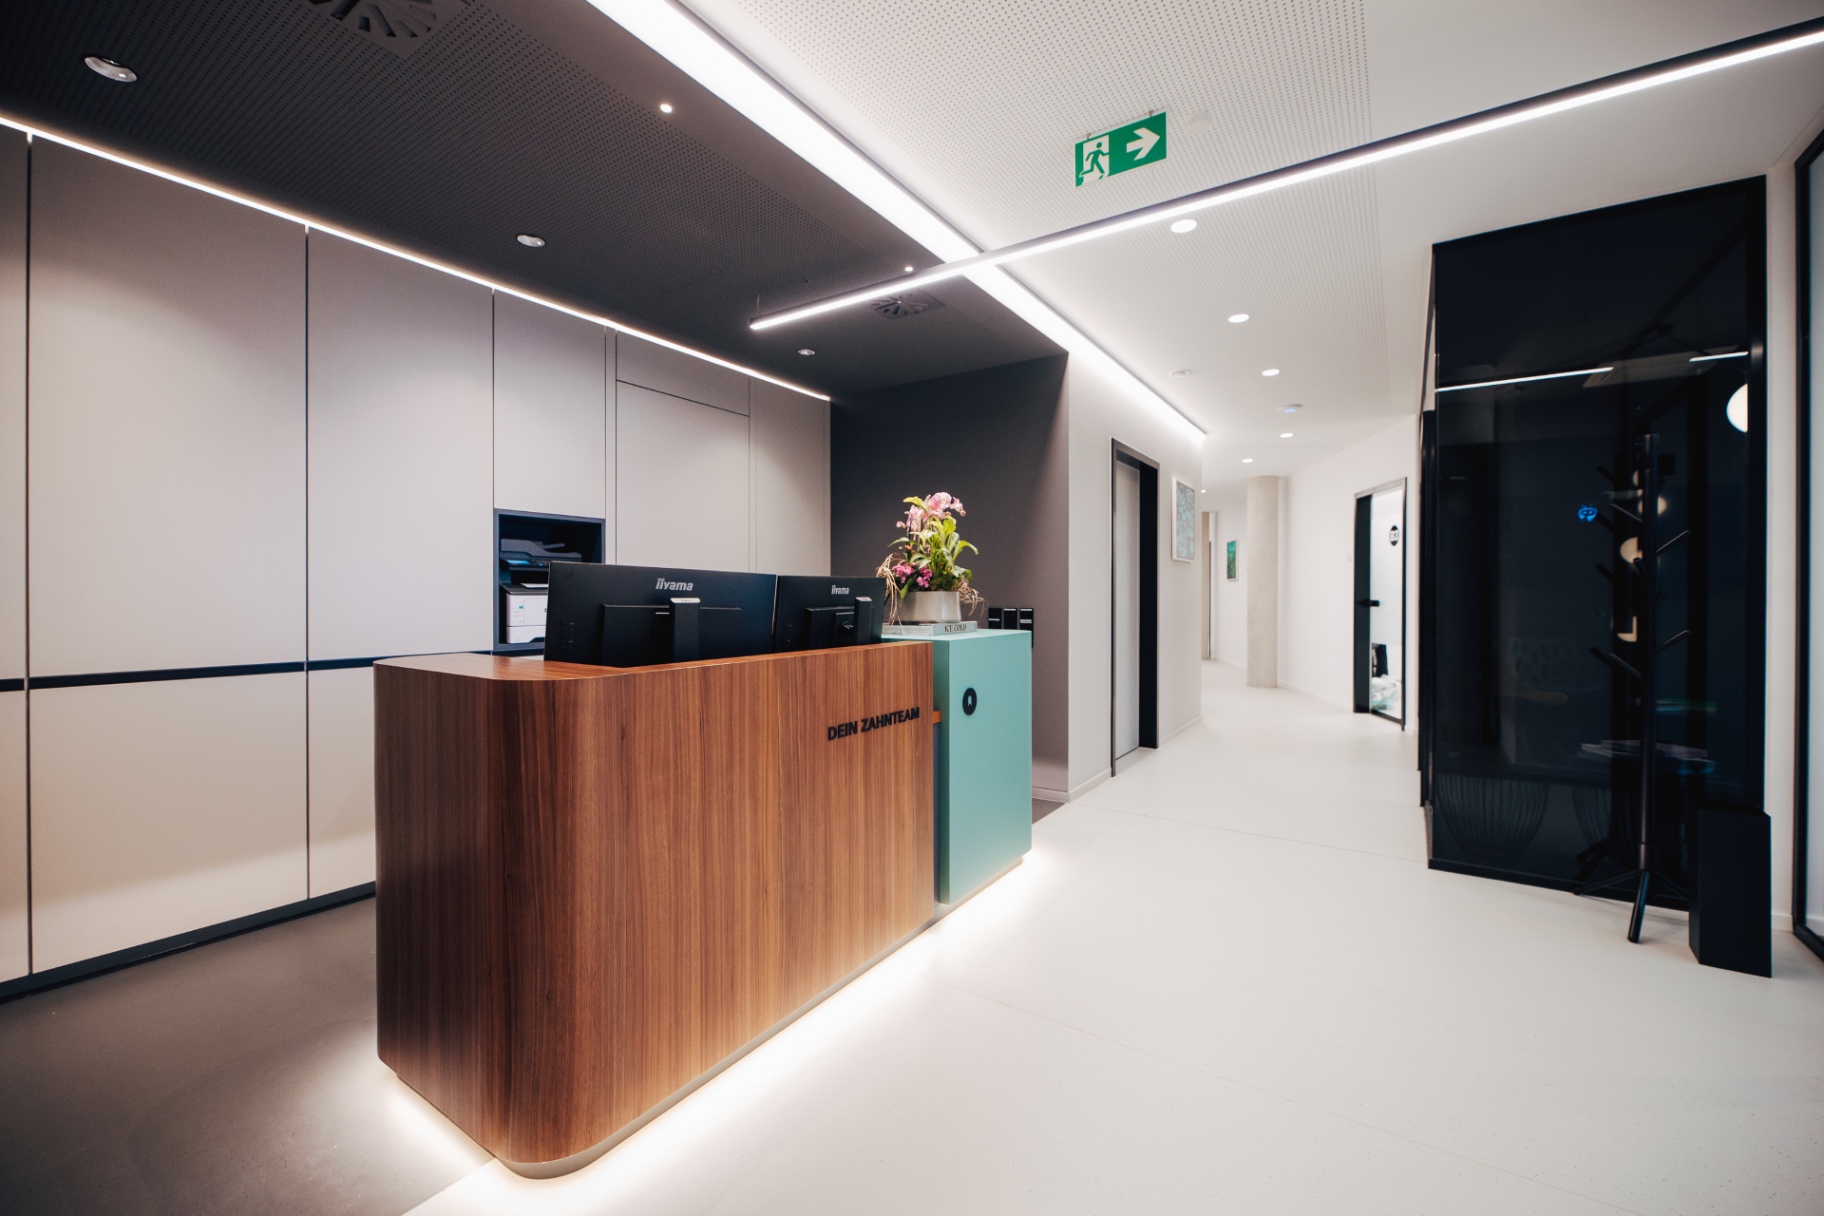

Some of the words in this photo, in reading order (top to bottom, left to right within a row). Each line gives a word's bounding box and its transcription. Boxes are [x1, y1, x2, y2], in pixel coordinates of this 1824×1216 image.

[655, 577, 694, 591] iiyama
[831, 584, 850, 595] iiyama
[827, 720, 858, 741] DEIN
[861, 706, 920, 733] ZAHNTEAM
